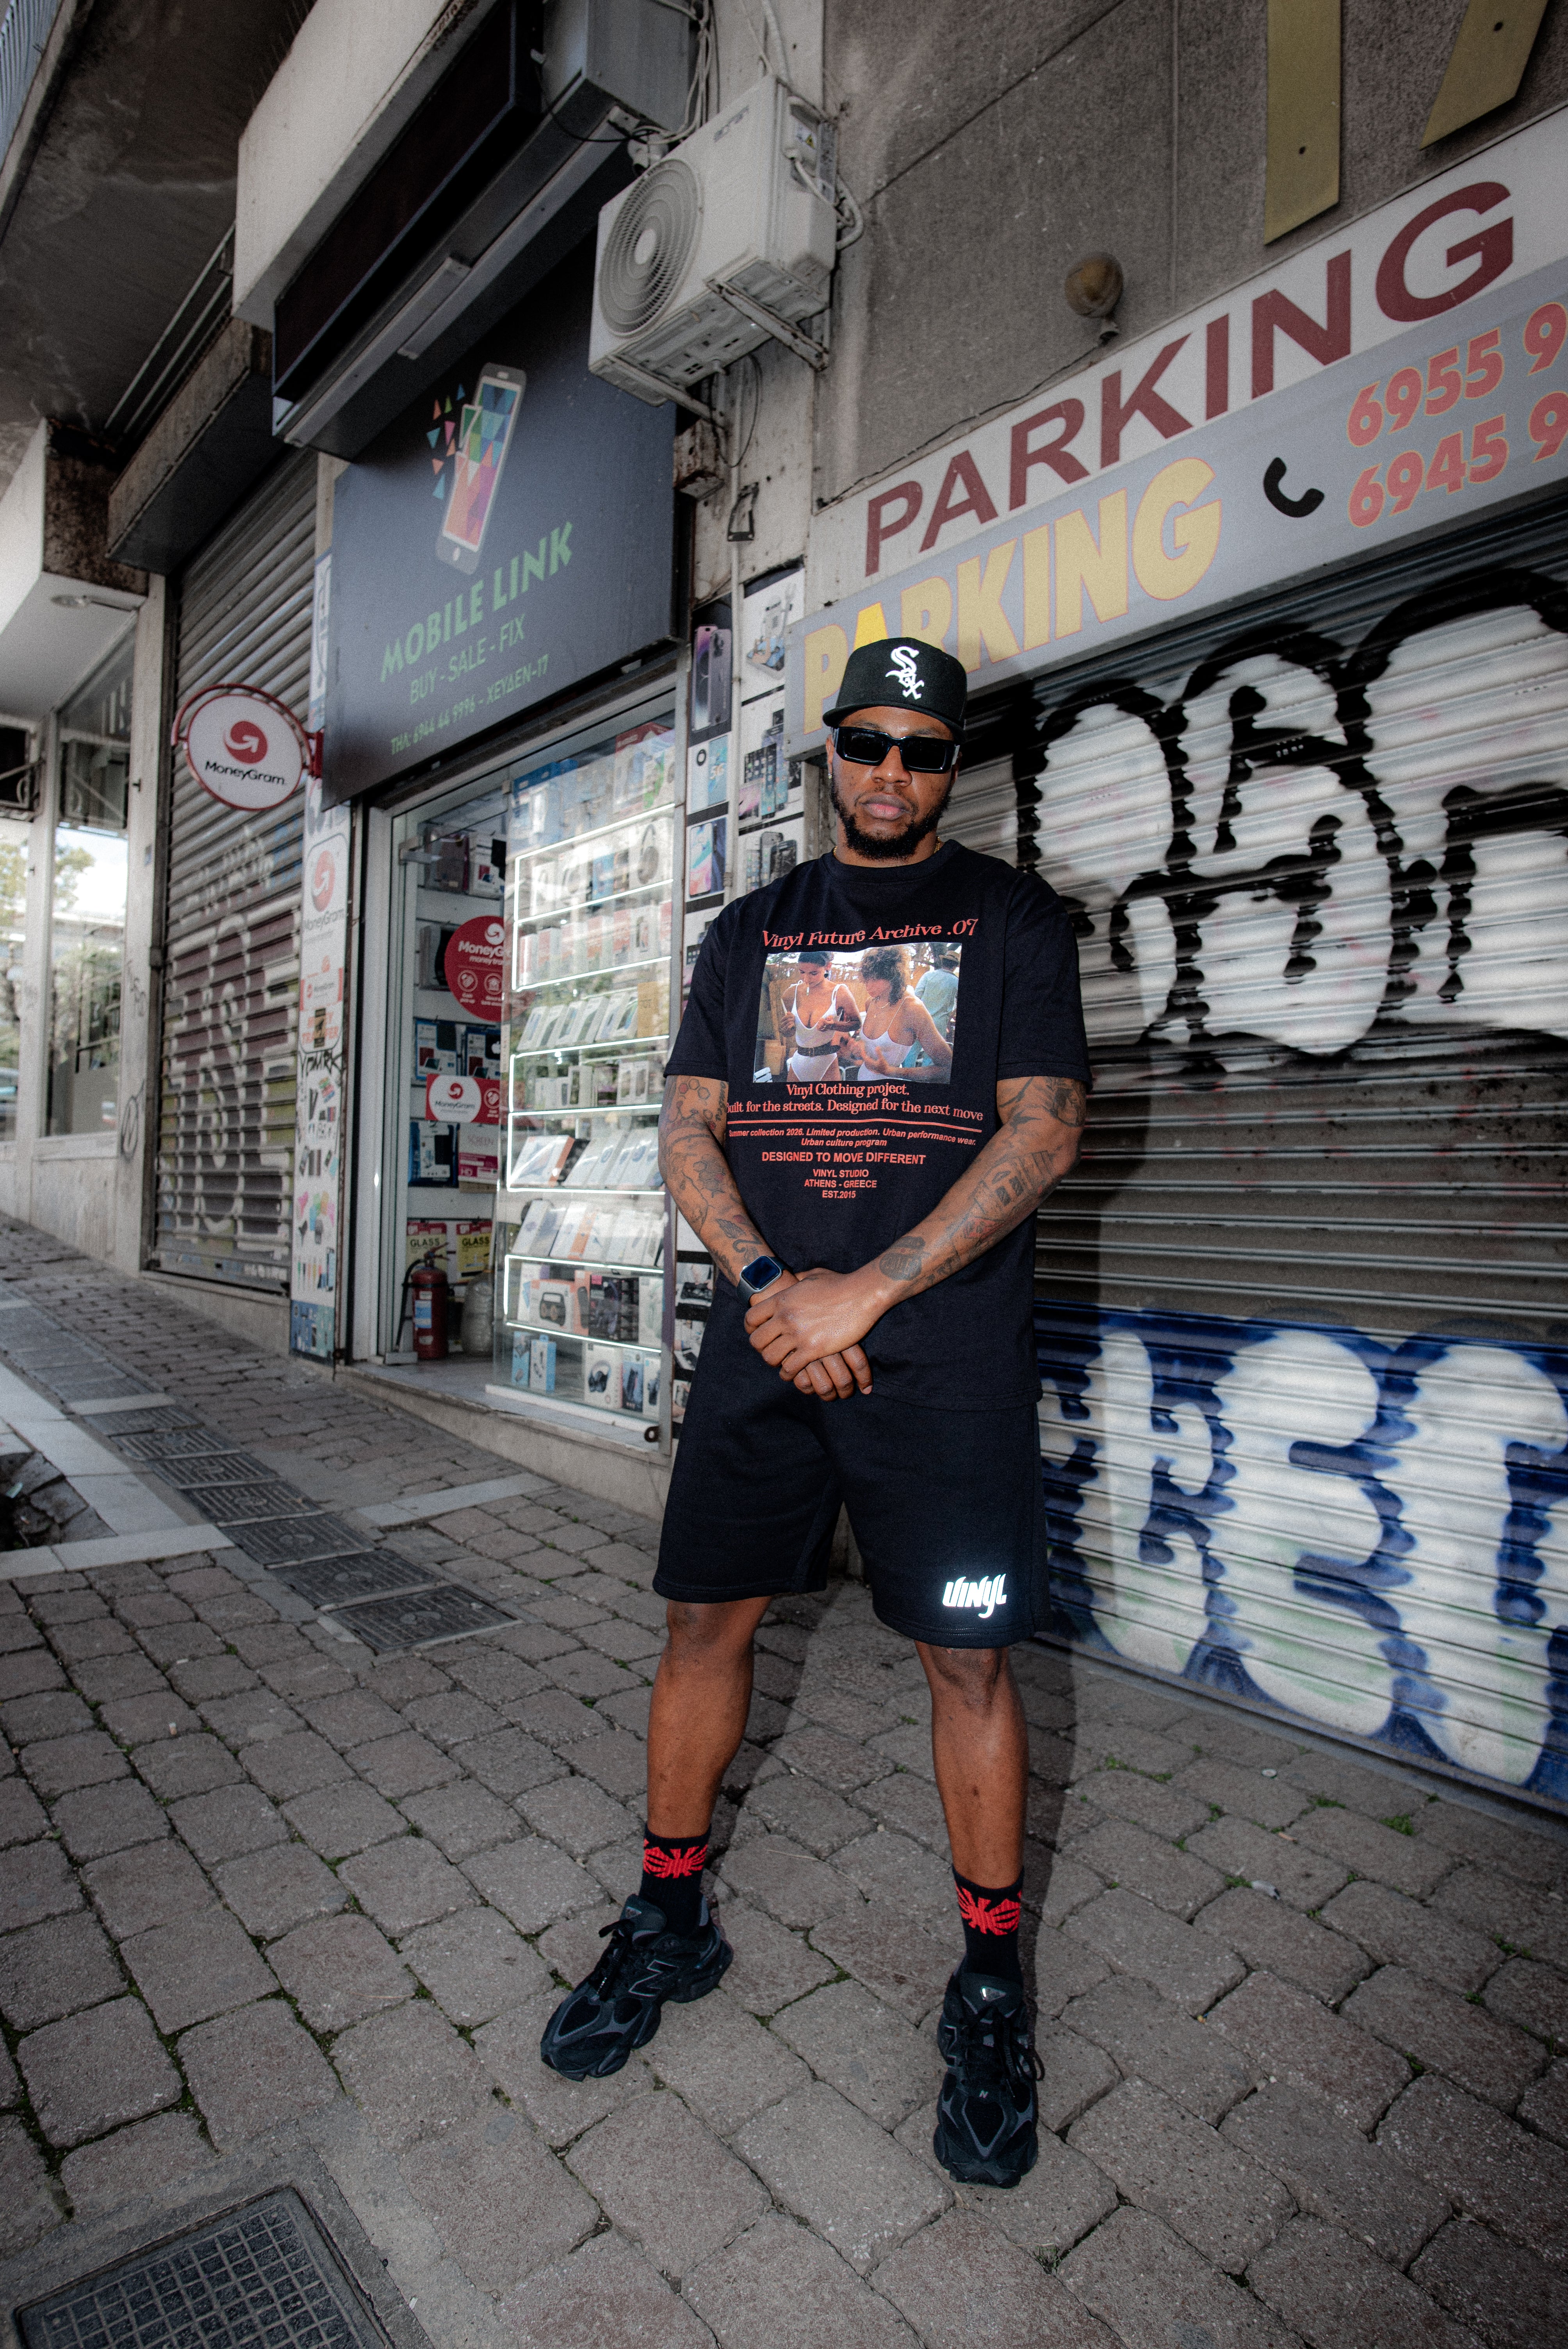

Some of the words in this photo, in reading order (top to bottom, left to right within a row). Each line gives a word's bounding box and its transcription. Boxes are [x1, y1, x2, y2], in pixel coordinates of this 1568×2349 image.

[865, 181, 1513, 578] PARKING
[1346, 326, 1505, 447] 6955
[1523, 301, 1567, 377] 9
[1348, 413, 1510, 528] 6945
[380, 579, 484, 683] MOBILE
[493, 521, 573, 612] LINK
[410, 666, 438, 704] BUY
[447, 637, 487, 683] SALE
[499, 613, 526, 653] FIX
[437, 708, 451, 729] 44
[205, 760, 285, 786] MoneyGram
[762, 930, 804, 950] Vinyl
[807, 930, 866, 945] Future
[869, 924, 942, 939] Archive
[947, 919, 978, 936] .07
[786, 1084, 813, 1099] Vinyl
[815, 1083, 865, 1098] Clothing
[866, 1083, 909, 1098] project.
[435, 1101, 475, 1109] MoneyGram
[746, 1101, 761, 1112] for
[763, 1100, 781, 1112] the
[782, 1102, 824, 1112] streets.
[827, 1099, 878, 1115] Designed
[881, 1098, 899, 1111] for
[901, 1100, 921, 1113] the
[923, 1105, 950, 1116] next
[953, 1108, 983, 1121] move
[786, 1128, 804, 1136] 2026.
[806, 1128, 836, 1136] Limited
[836, 1128, 880, 1137] production.
[883, 1128, 906, 1137] Urban
[907, 1131, 956, 1142] performance
[957, 1137, 976, 1145] wear.
[854, 1139, 887, 1148] program
[762, 1151, 813, 1162] DESIGNED
[816, 1152, 831, 1162] TO
[833, 1152, 863, 1163] MOVE
[866, 1152, 926, 1164] DIFFERENT
[813, 1169, 837, 1178] VINYL
[839, 1169, 869, 1178] STUDIO
[804, 1179, 837, 1188] ATHENS
[843, 1180, 877, 1188] GREECE
[822, 1190, 856, 1199] EST.2015
[410, 1237, 440, 1248] GLASS
[461, 1236, 490, 1247] GLASS
